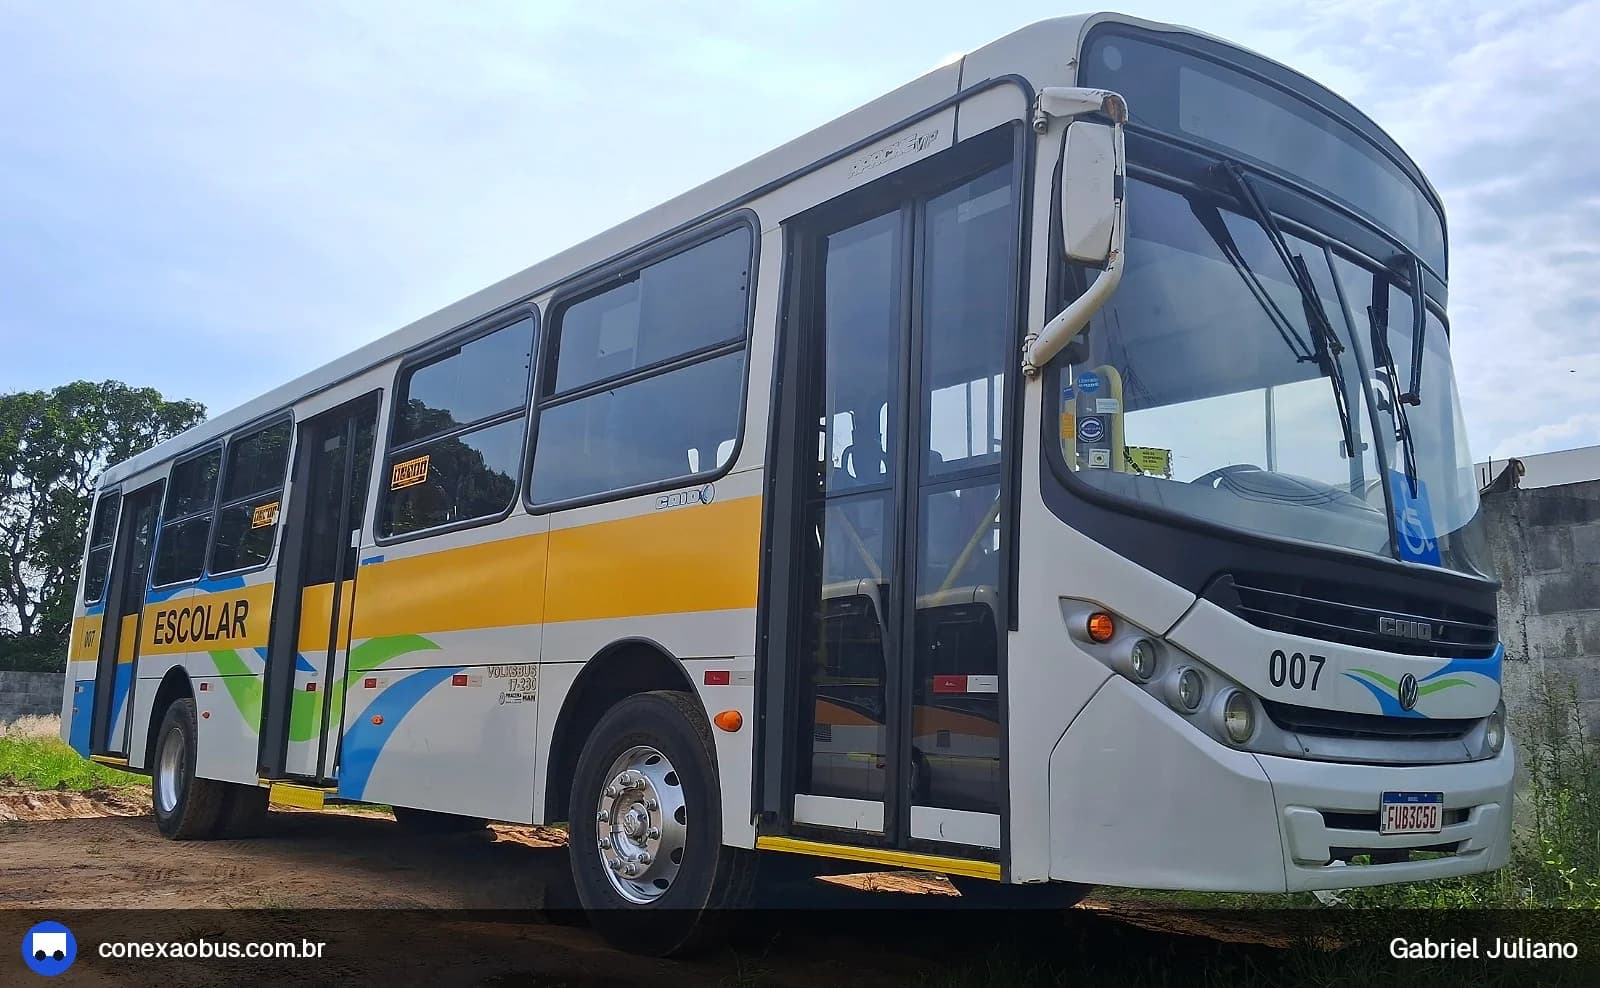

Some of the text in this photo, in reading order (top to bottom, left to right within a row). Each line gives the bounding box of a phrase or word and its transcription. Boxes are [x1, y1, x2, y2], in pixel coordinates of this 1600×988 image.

[655, 490, 701, 509] CAIO
[153, 599, 249, 645] ESCOLAR
[1379, 616, 1431, 640] CAIO
[84, 629, 96, 648] 007
[487, 665, 537, 678] VOLKSBUS
[1269, 650, 1326, 691] 007
[1387, 805, 1437, 830] FUB3C50
